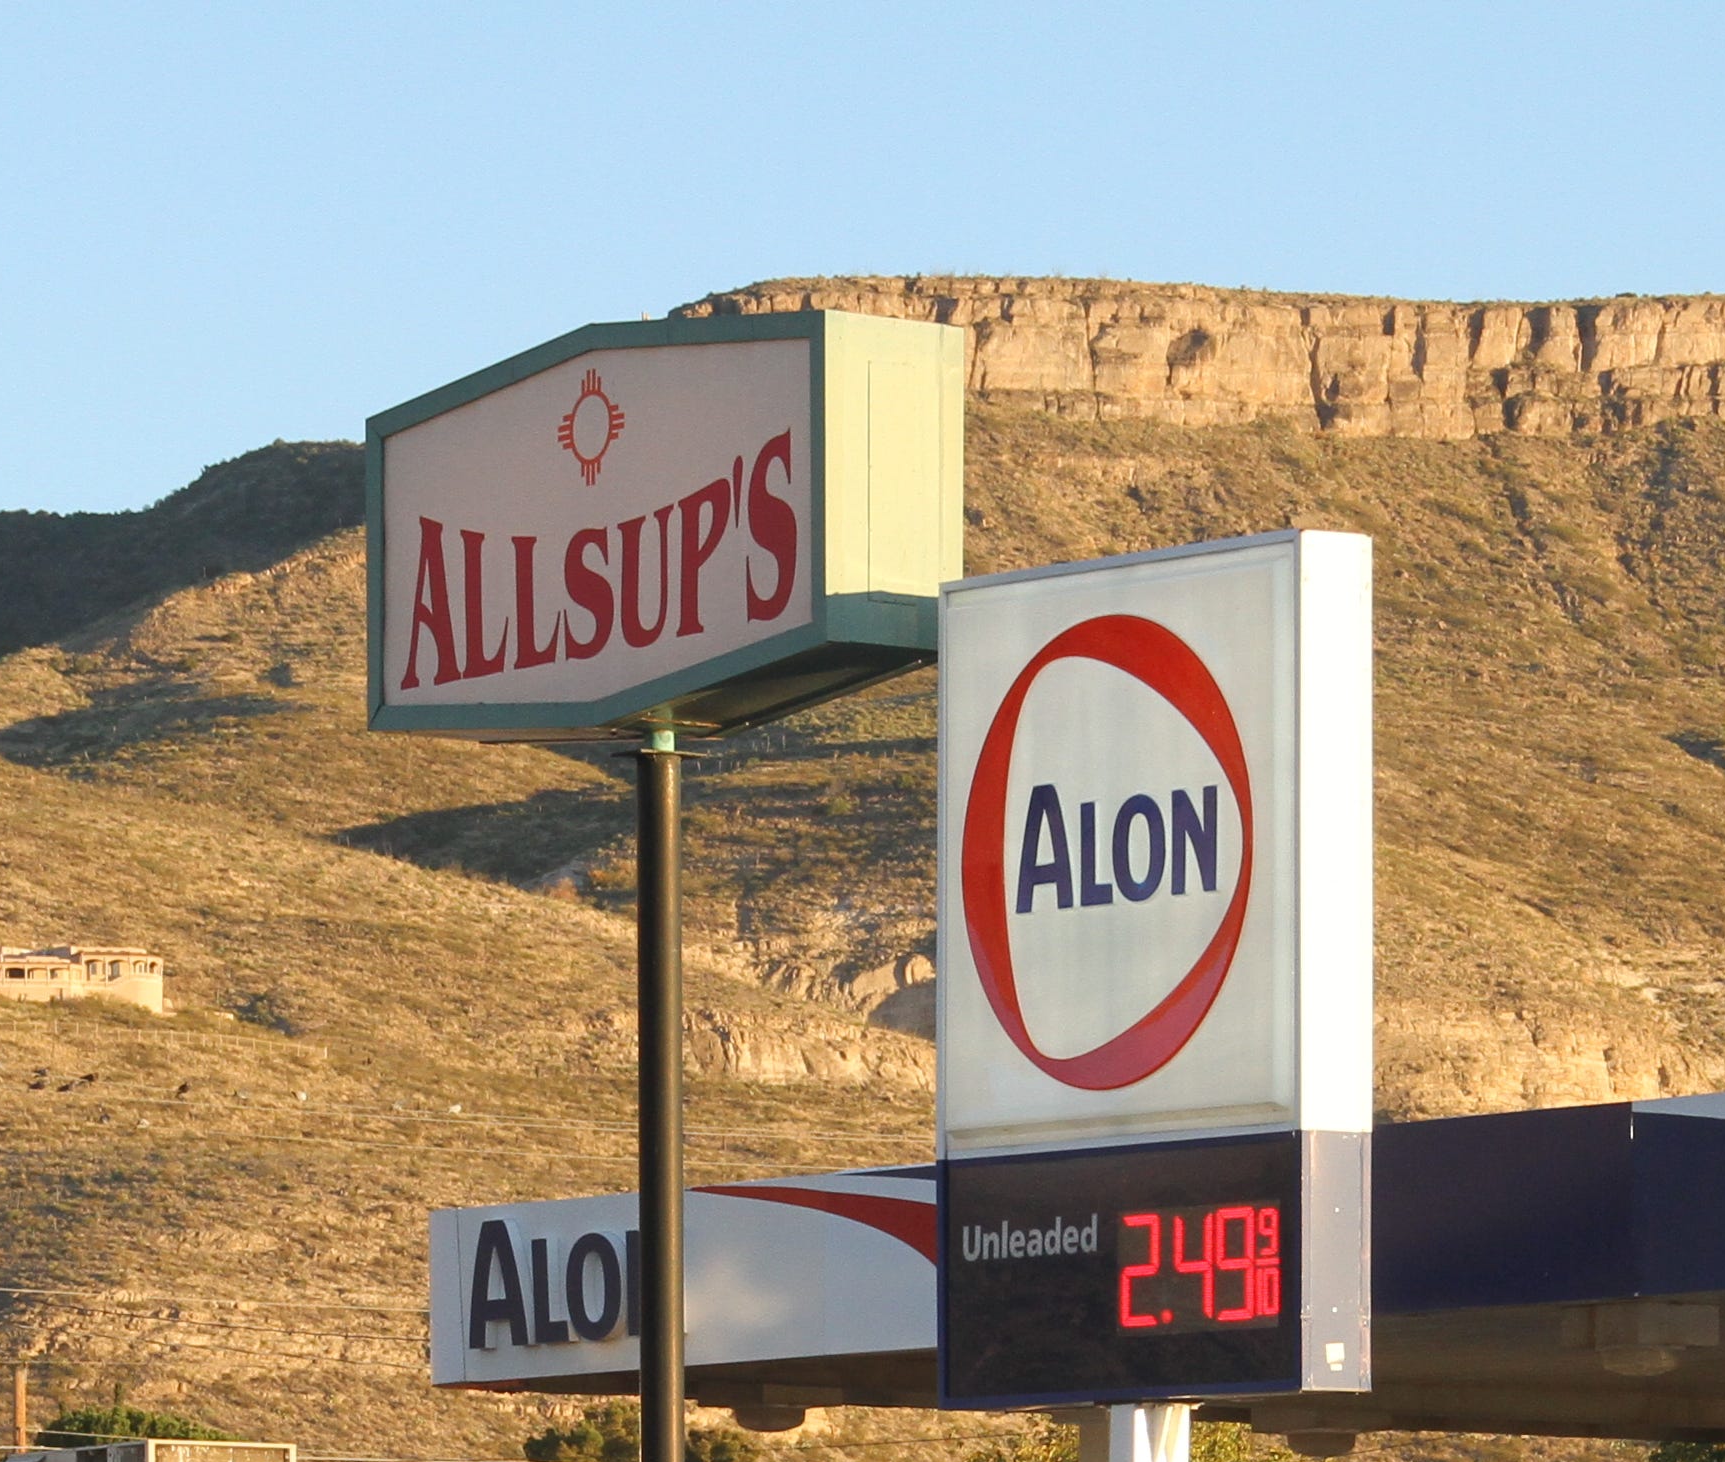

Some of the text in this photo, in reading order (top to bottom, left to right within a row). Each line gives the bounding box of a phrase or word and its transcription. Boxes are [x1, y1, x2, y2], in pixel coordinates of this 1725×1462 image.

[400, 427, 798, 690] ALLSUP'S
[1015, 783, 1219, 915] ALON
[469, 1218, 640, 1350] ALO
[962, 1212, 1099, 1263] Unleaded
